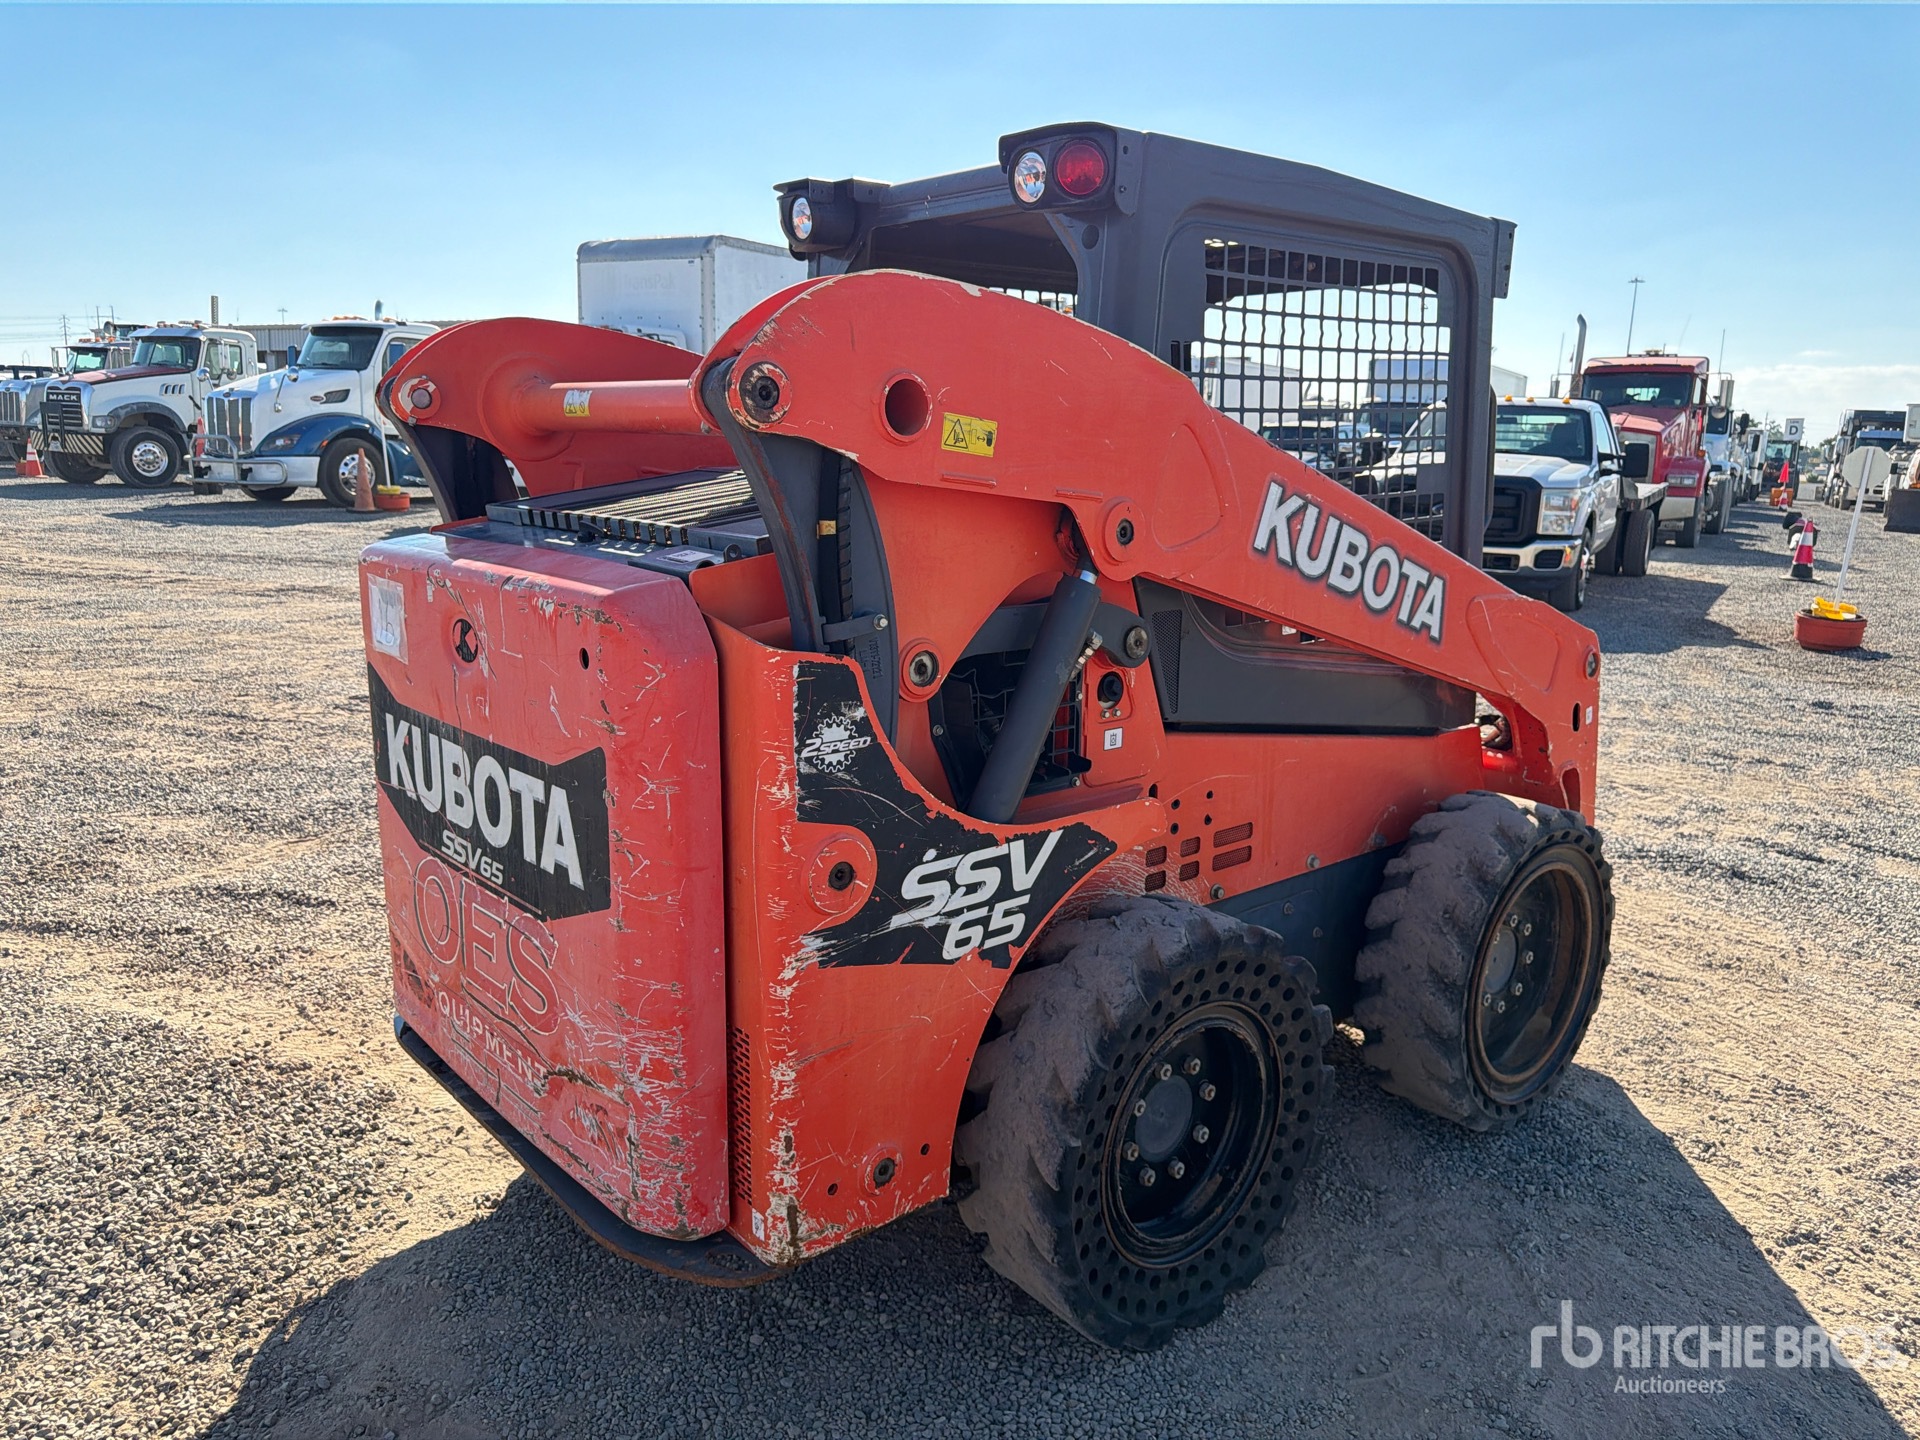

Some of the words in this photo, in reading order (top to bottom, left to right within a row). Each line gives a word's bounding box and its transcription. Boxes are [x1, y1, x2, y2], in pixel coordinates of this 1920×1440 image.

[1789, 425, 1799, 436] D
[1254, 481, 1446, 642] KUBOTA
[384, 713, 585, 891] KUBOTA
[890, 830, 1064, 930] SSV
[941, 894, 1031, 961] 65
[414, 856, 561, 1036] OES
[435, 989, 548, 1086] QUIPMENT
